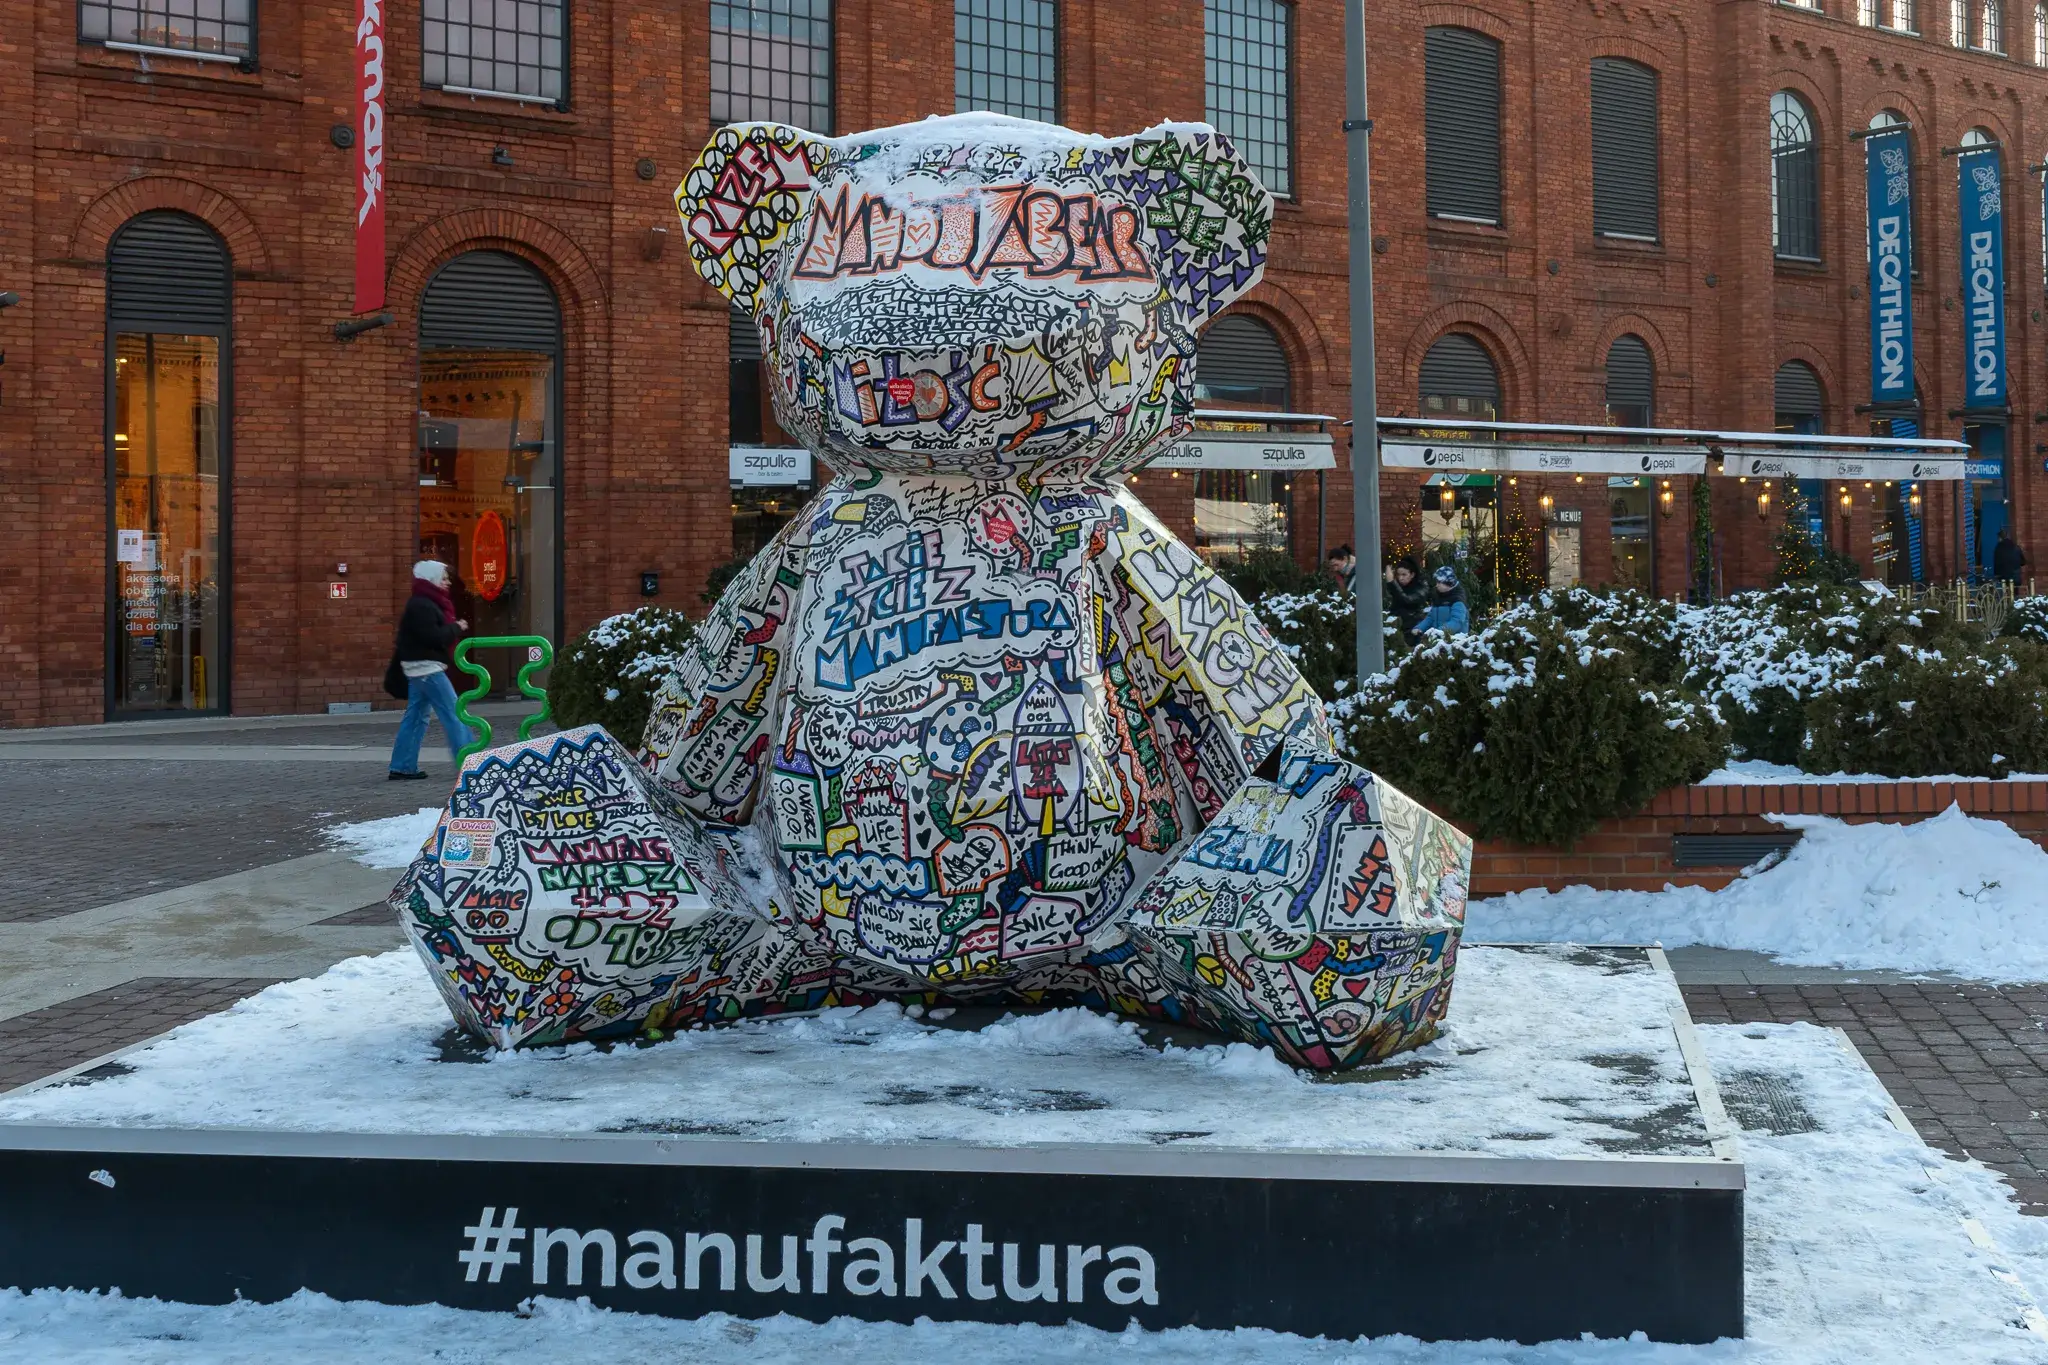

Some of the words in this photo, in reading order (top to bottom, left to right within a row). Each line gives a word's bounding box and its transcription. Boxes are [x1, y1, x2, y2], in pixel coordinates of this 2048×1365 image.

[1877, 216, 1904, 389] DECATHLON
[1970, 231, 1997, 396] DECATHLON
[744, 454, 797, 470] szpulka
[1263, 448, 1305, 462] szpulka
[1438, 450, 1465, 466] pepsi
[1653, 458, 1676, 470] pepsi
[1761, 461, 1783, 475] pepsi
[1922, 465, 1940, 477] pepsi
[483, 560, 496, 572] small
[126, 573, 181, 584] akcesoria
[483, 572, 496, 584] prices
[934, 564, 975, 606] Z
[126, 610, 159, 619] dzieci
[126, 622, 143, 631] dla
[146, 622, 178, 631] domu
[1025, 697, 1057, 709] MANU
[1049, 862, 1089, 880] GOOD
[862, 901, 903, 924] NIGDY
[458, 1205, 1159, 1305] #manufaktura
